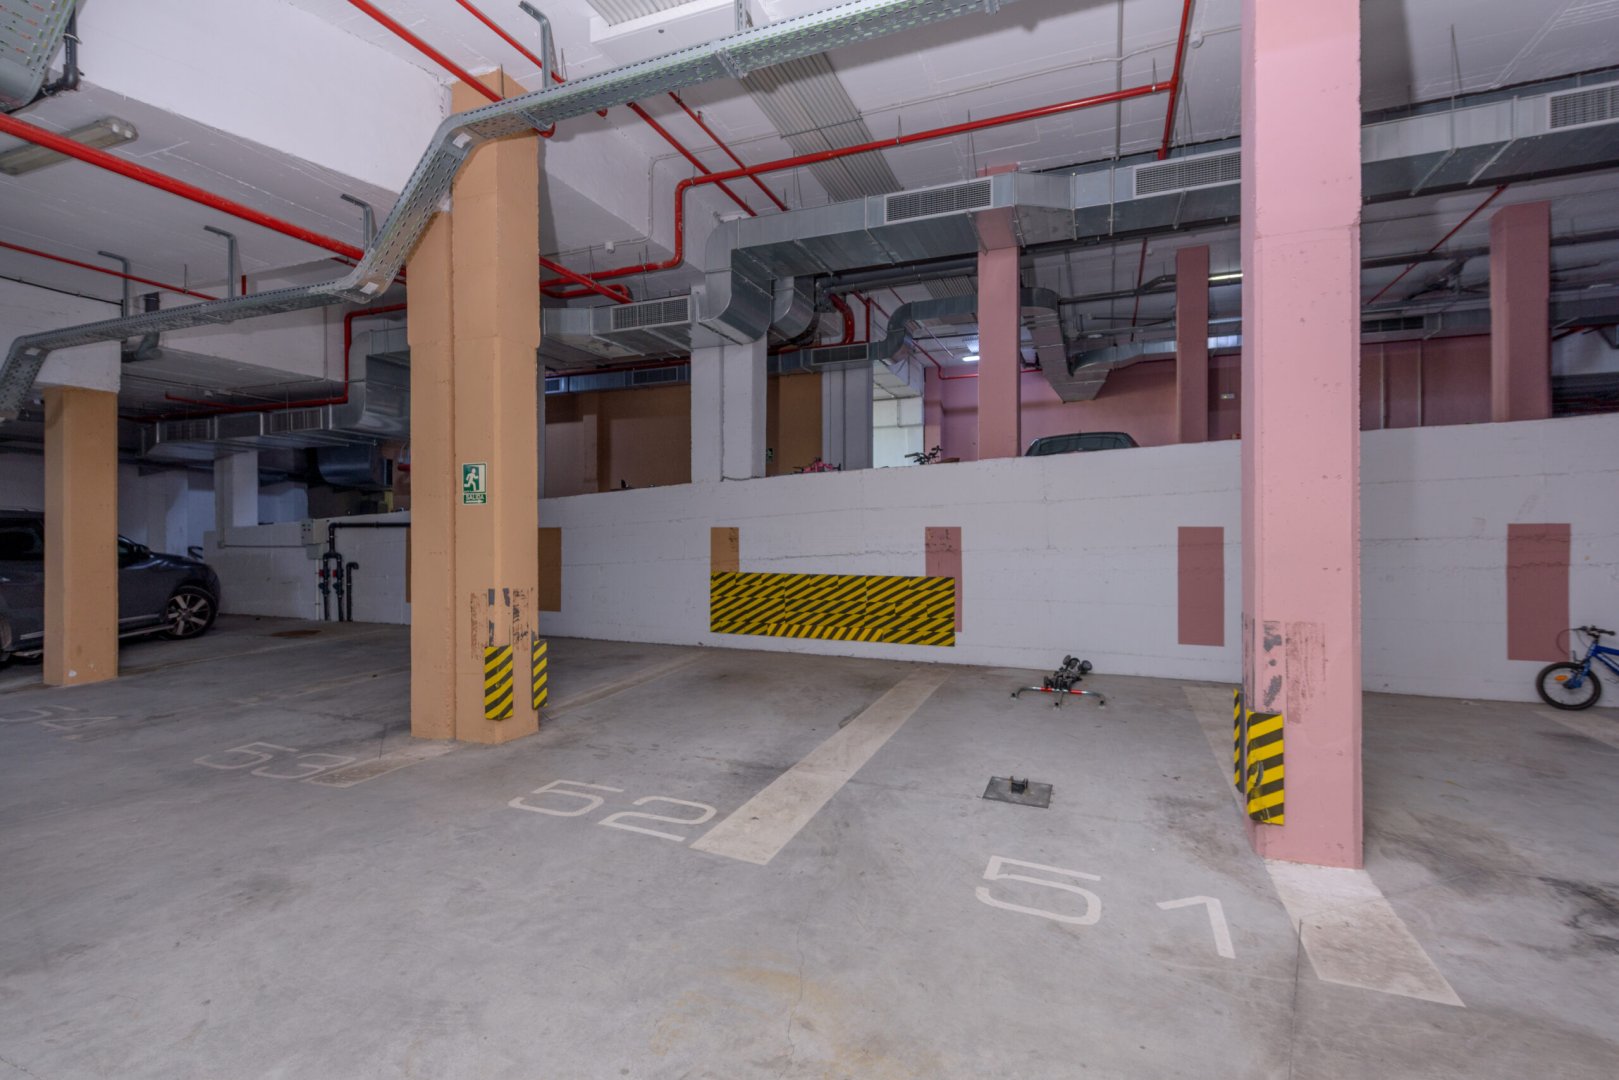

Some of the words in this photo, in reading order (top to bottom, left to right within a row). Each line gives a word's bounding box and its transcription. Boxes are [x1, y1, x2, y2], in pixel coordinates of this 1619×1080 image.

[193, 741, 357, 779] 53
[508, 779, 717, 842] 52
[975, 855, 1236, 959] 51
